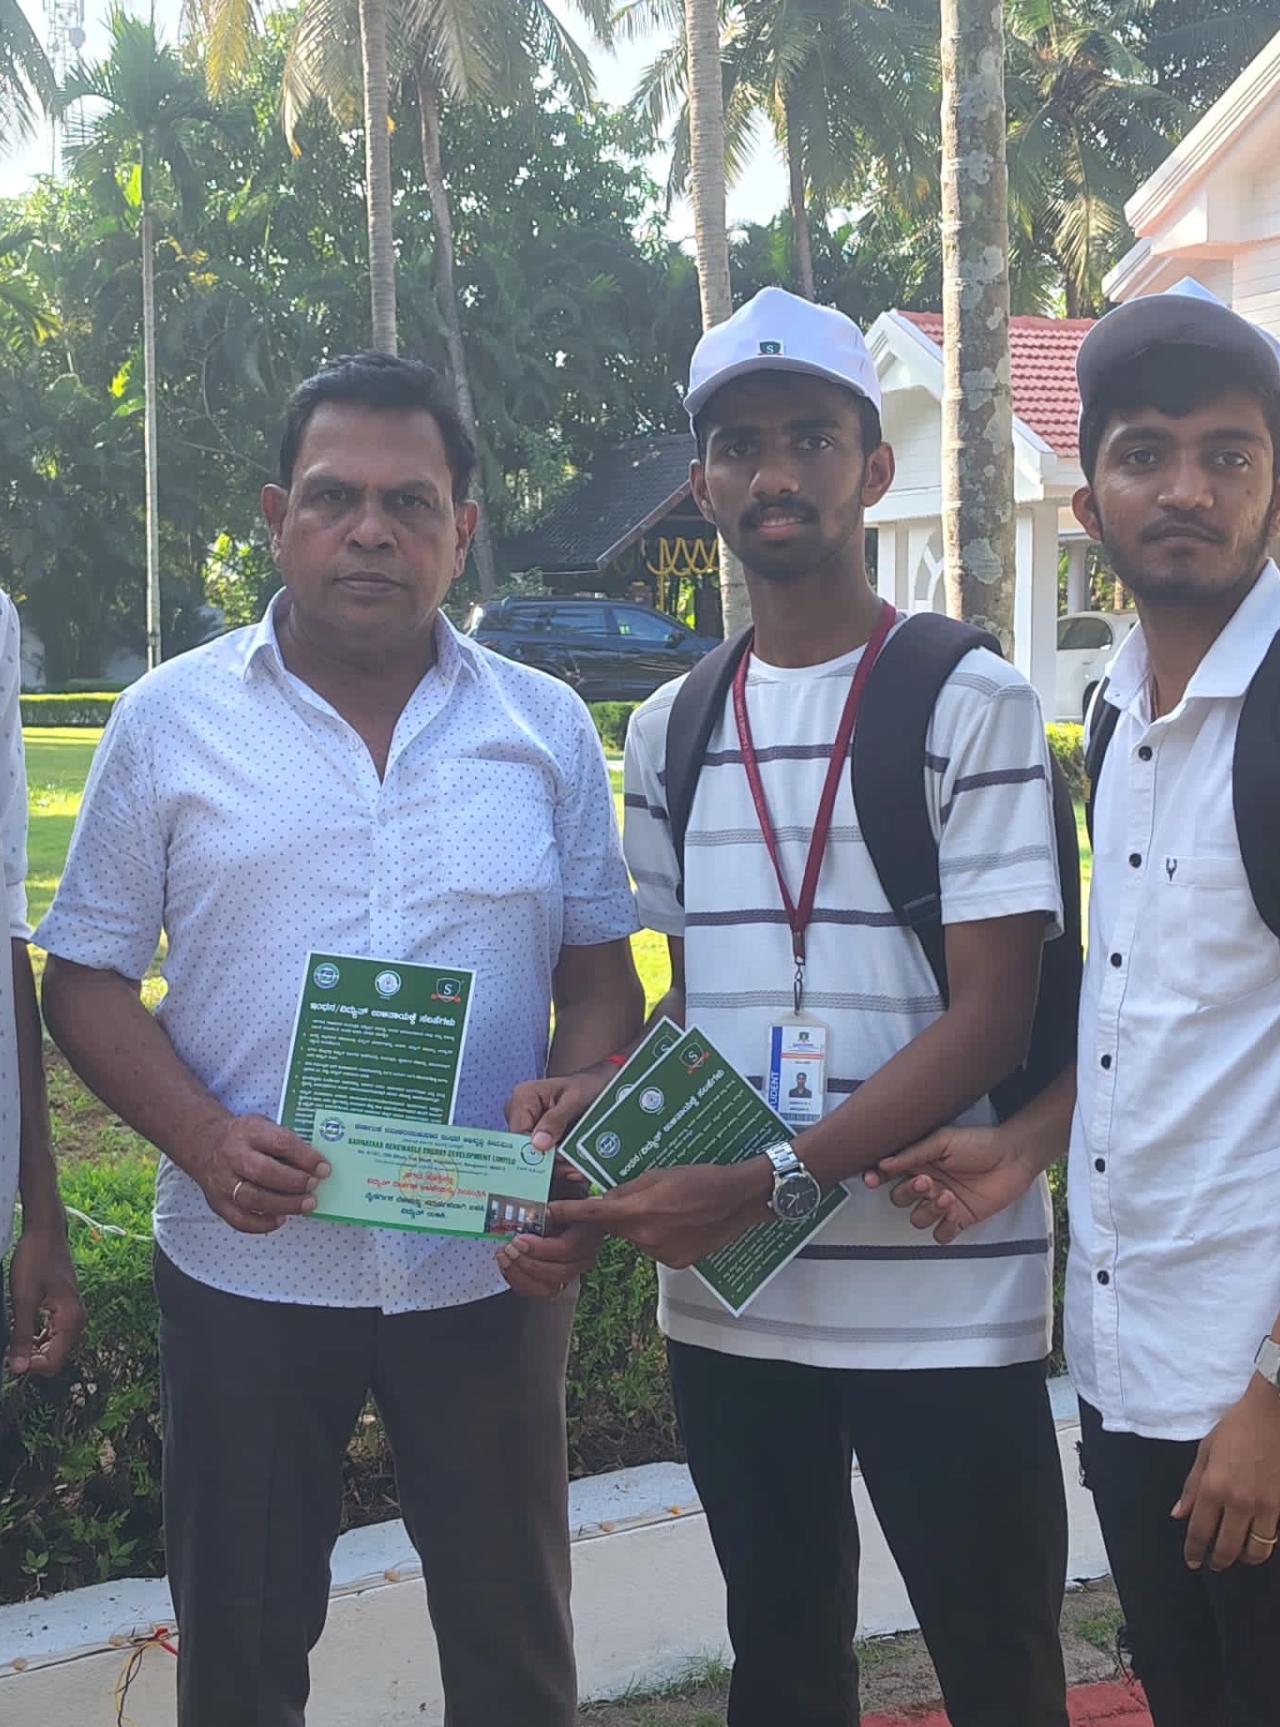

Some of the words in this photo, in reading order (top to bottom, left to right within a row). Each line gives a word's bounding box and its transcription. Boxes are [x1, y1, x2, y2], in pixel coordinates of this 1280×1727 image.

[443, 983, 453, 995] S
[688, 1050, 699, 1062] S
[448, 1149, 491, 1161] DEVELOPMENT
[492, 1154, 516, 1165] LIMITED
